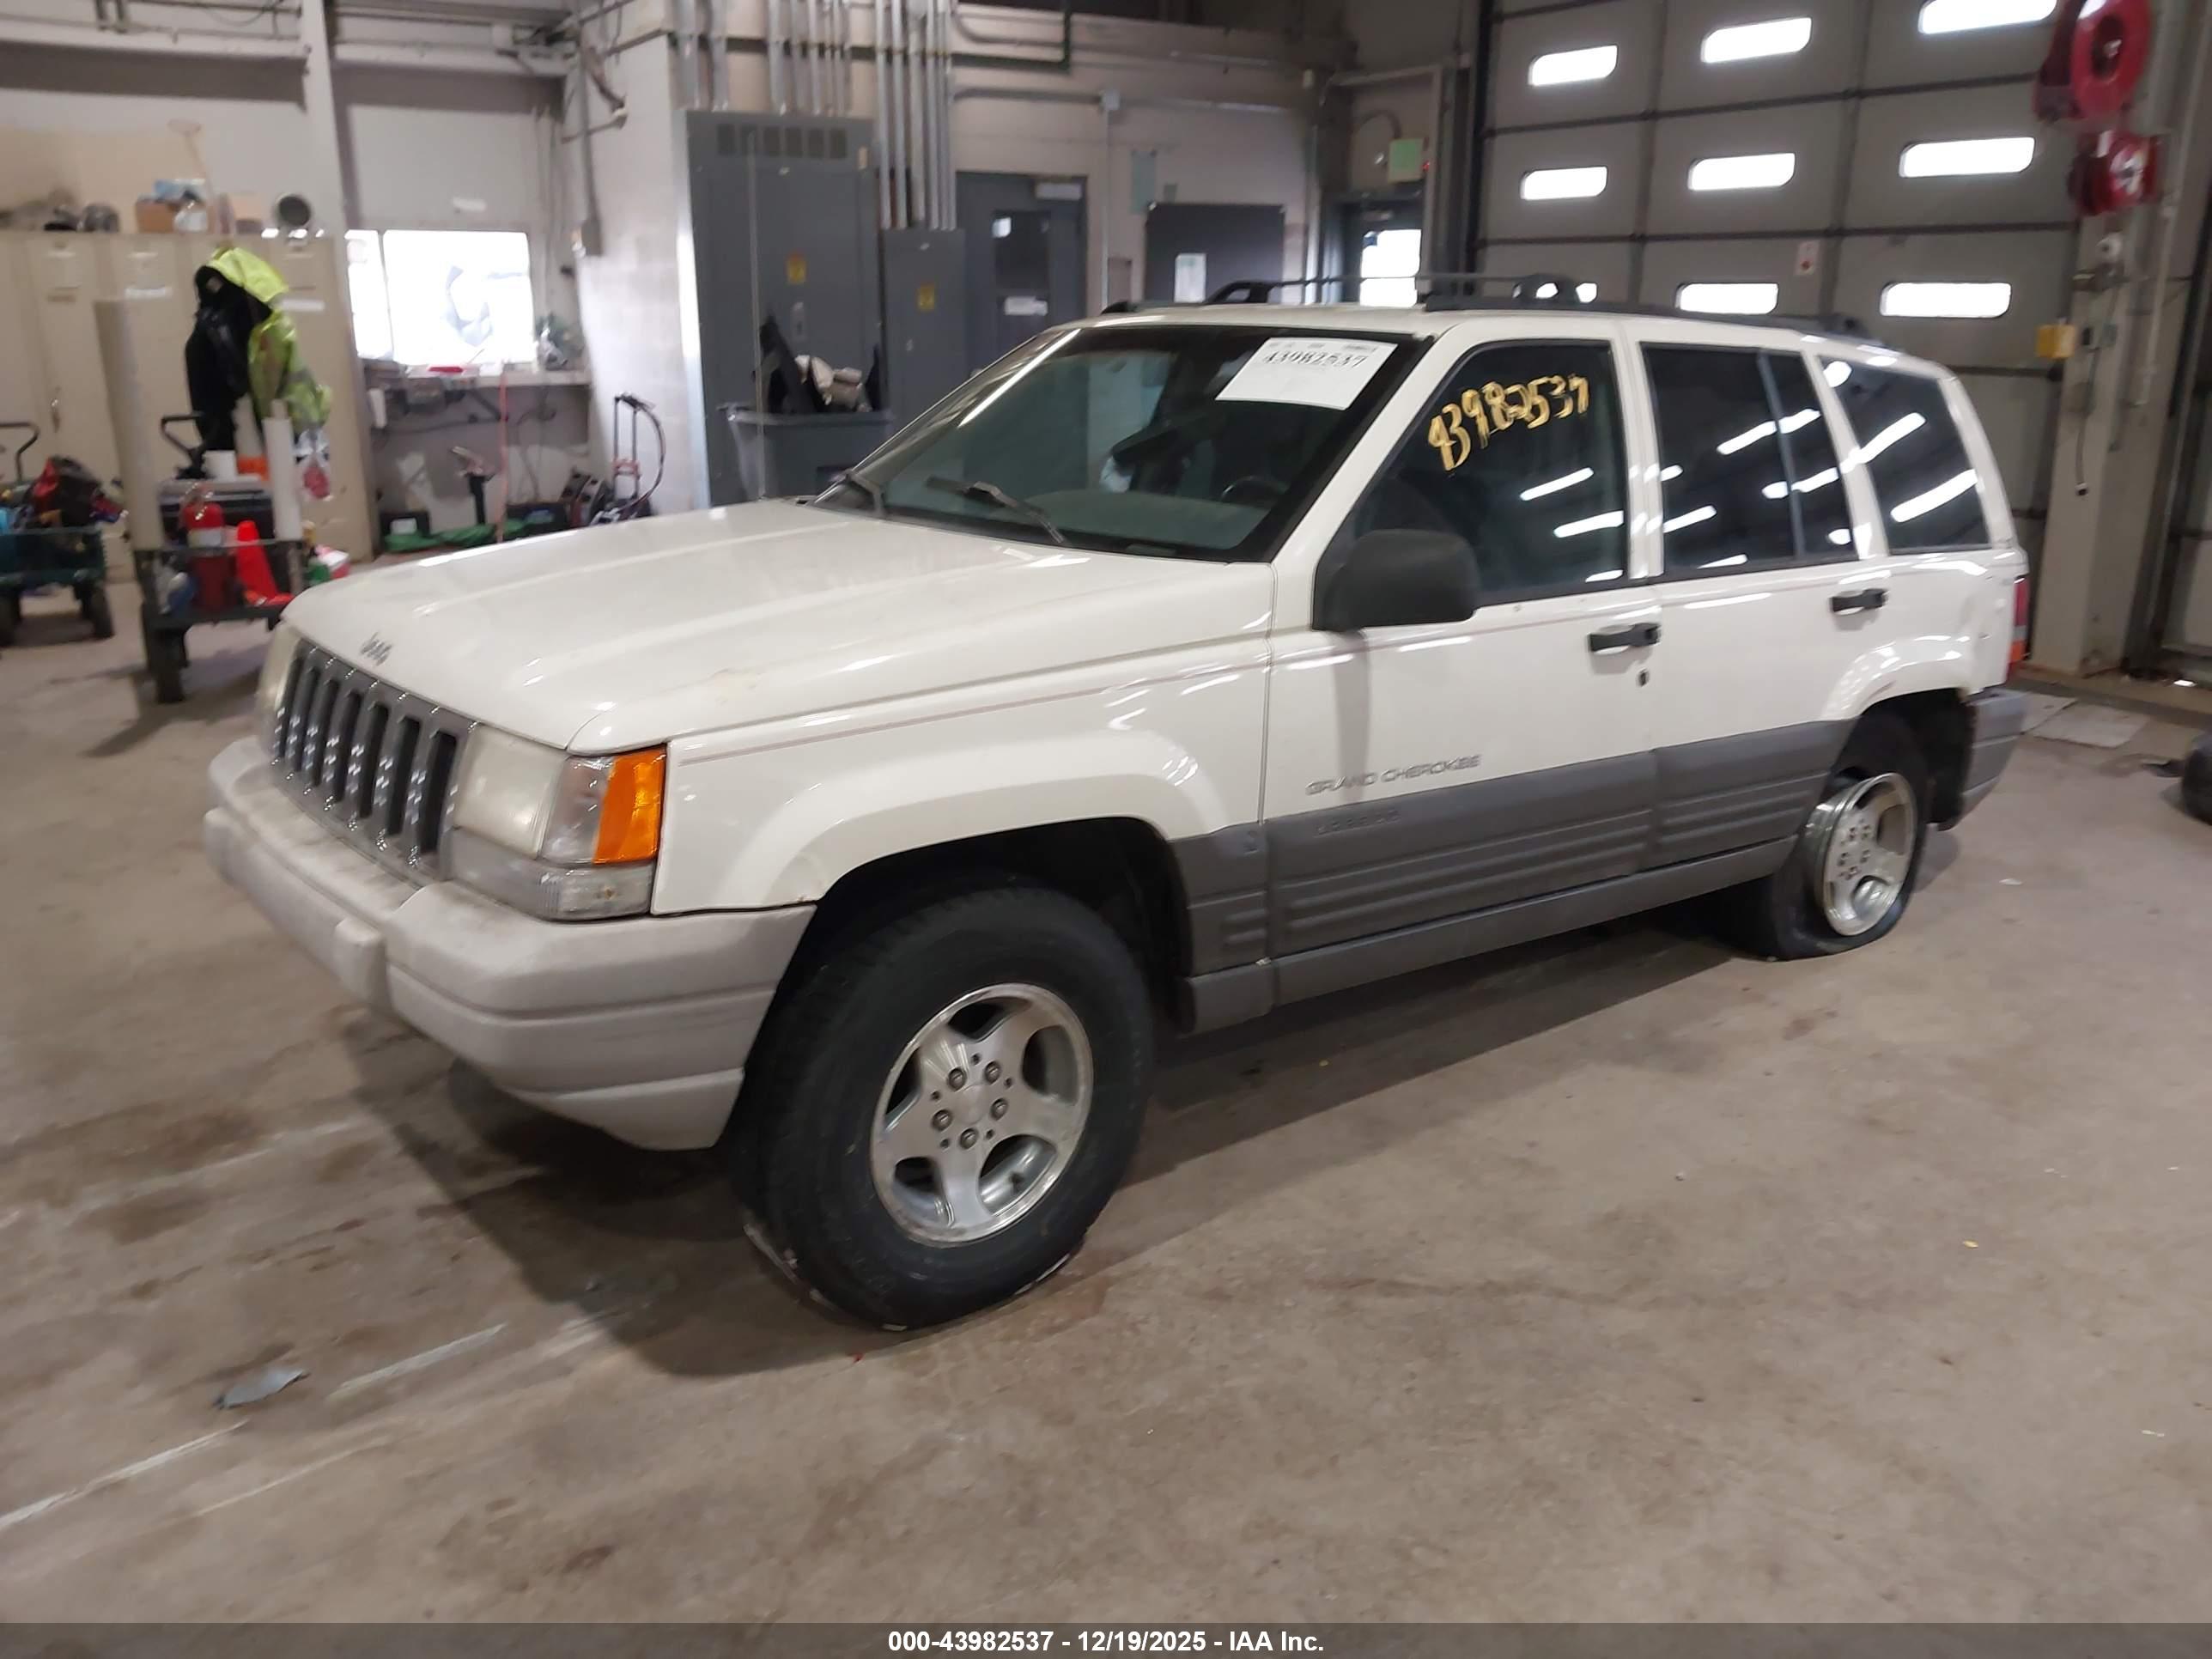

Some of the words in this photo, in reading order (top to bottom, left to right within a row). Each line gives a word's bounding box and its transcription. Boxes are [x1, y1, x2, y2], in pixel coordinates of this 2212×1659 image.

[1264, 350, 1369, 369] 43982537
[1428, 374, 1589, 471] 43982537
[1306, 774, 1377, 795] GRAND
[1381, 755, 1480, 782] CHEROKEE
